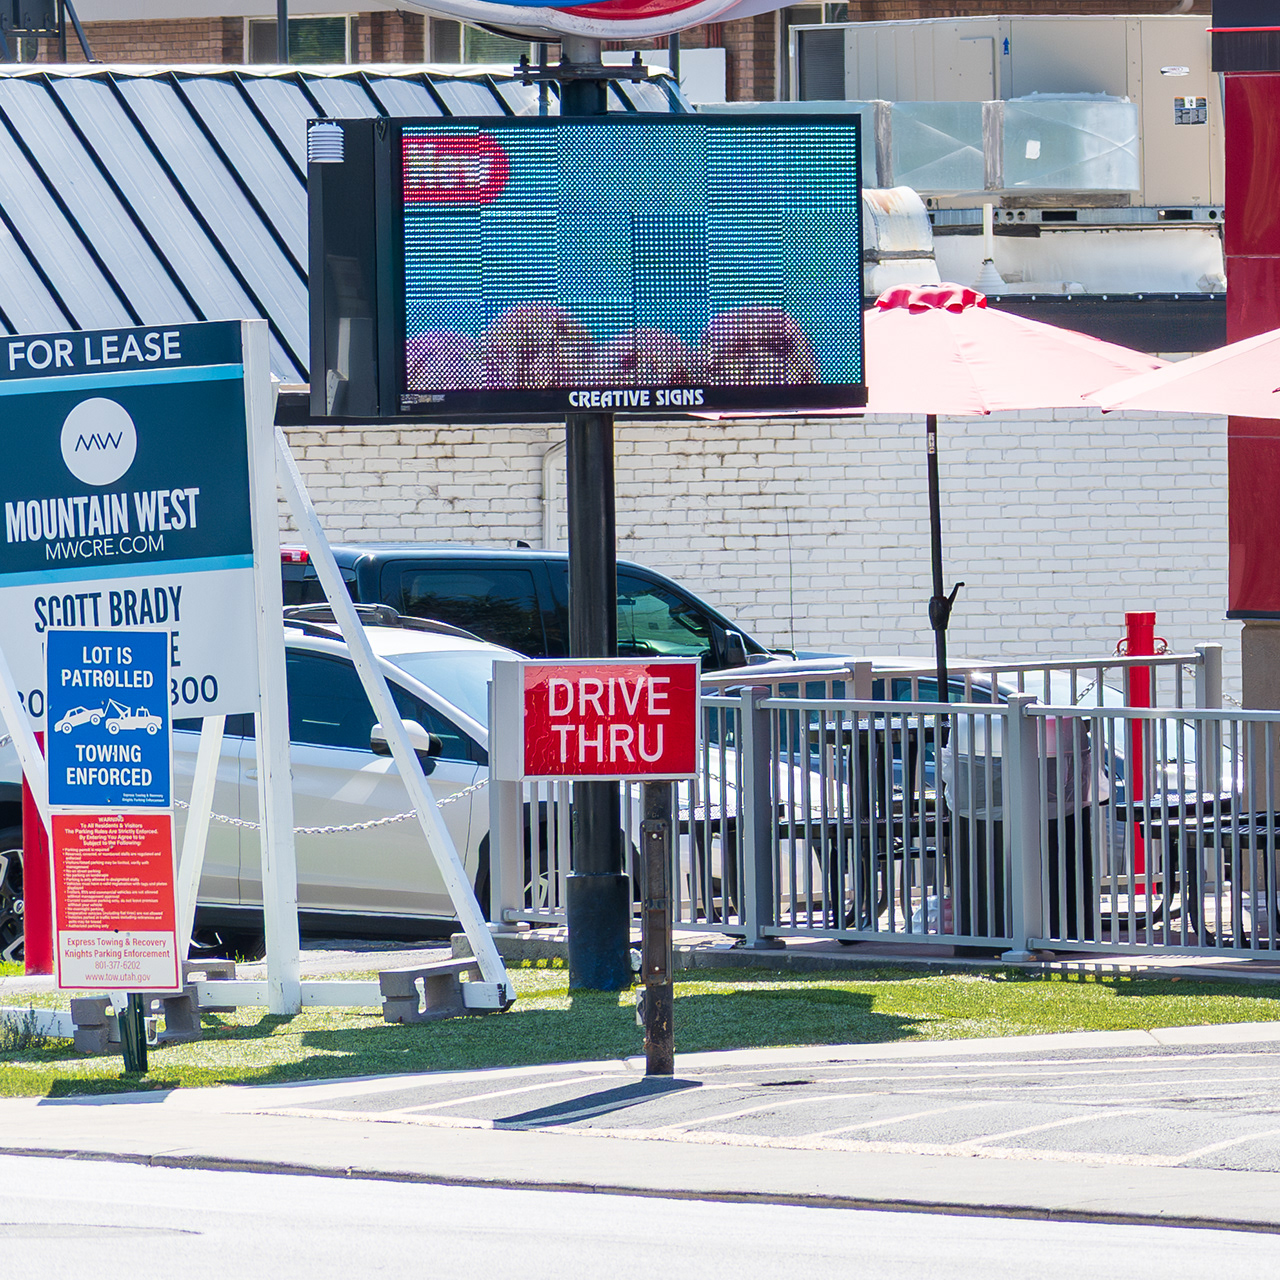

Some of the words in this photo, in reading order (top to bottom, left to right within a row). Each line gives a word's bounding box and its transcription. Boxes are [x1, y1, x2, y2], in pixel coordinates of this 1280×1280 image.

[8, 337, 74, 371] FOR
[84, 331, 182, 366] LEASE
[568, 390, 650, 408] CREATIVE
[655, 389, 704, 406] SIGNS
[5, 494, 129, 543] MOUNTAIN
[133, 487, 200, 530] WEST
[45, 535, 165, 560] MWCRE.COM
[34, 592, 102, 631] SCOTT
[109, 585, 183, 626] BRADY
[82, 646, 112, 666] LOT
[116, 646, 133, 666] IS
[61, 669, 154, 689] PATROLLED
[548, 676, 671, 717] DRIVE
[75, 743, 142, 763] TOWING
[550, 723, 664, 763] THRU
[66, 766, 153, 787] ENFORCED
[74, 828, 94, 836] Parking
[118, 828, 135, 836] Strictly
[67, 938, 95, 947] Express
[96, 938, 123, 948] Towing
[124, 938, 131, 946] &
[132, 938, 167, 948] Recovery
[64, 949, 93, 959] Knights
[94, 949, 122, 959] Parking
[123, 949, 170, 958] Enforcement
[94, 961, 141, 970] 801-377-6202
[85, 972, 151, 983] www.tow.utah.gov
